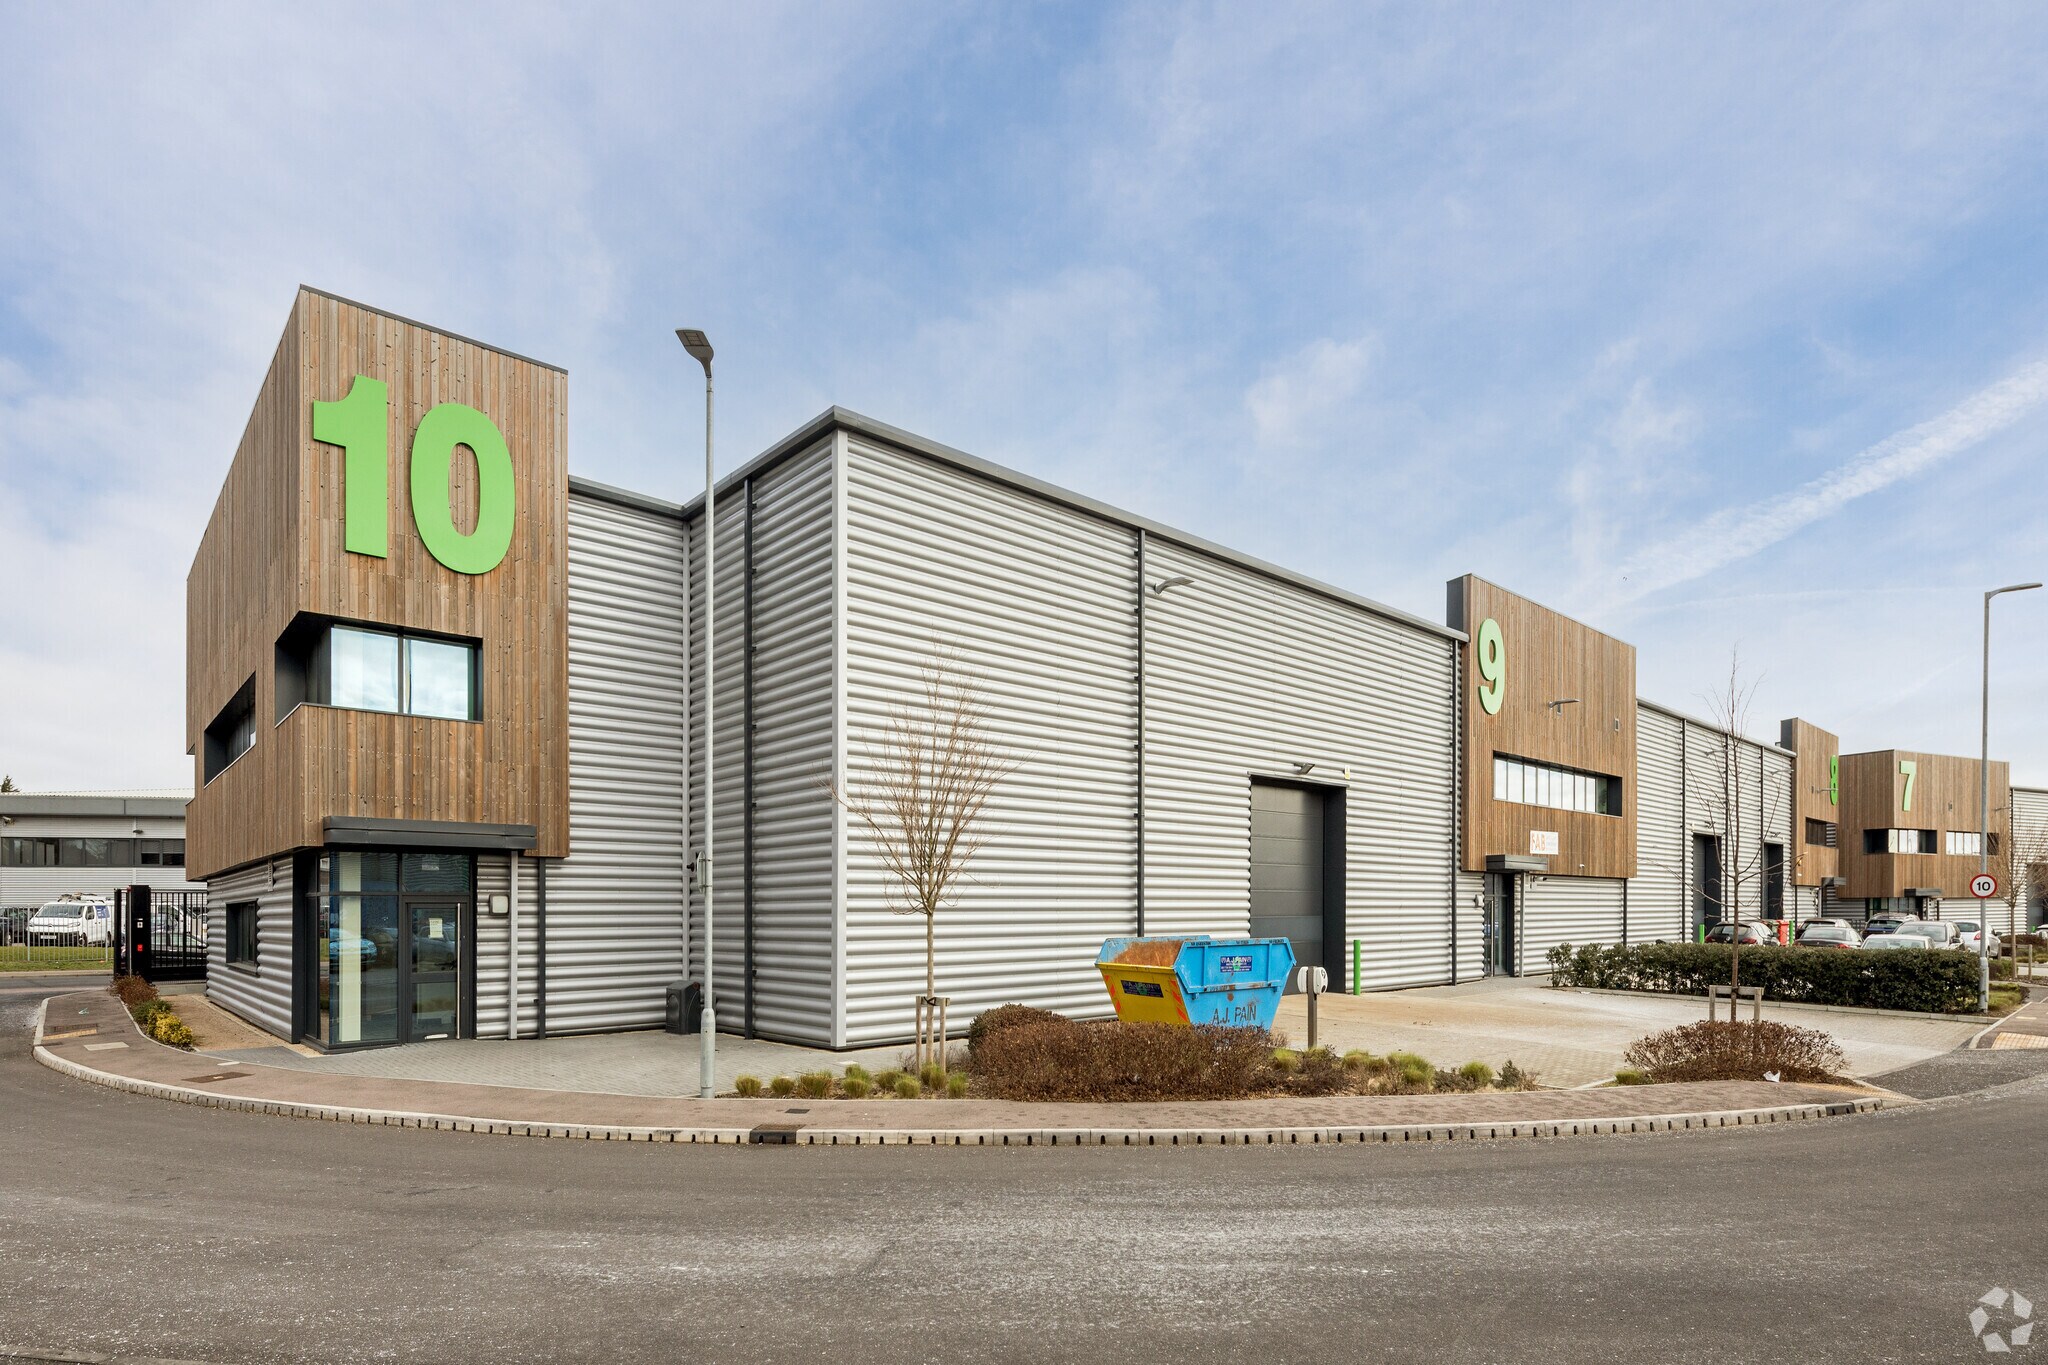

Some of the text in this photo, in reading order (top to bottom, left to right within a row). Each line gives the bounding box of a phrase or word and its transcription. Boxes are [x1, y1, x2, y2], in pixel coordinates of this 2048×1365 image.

[313, 374, 516, 575] 10
[1478, 618, 1506, 715] 9
[1899, 761, 1917, 811] 7
[1531, 832, 1546, 851] FAB
[1976, 881, 1991, 891] 10
[1234, 1004, 1257, 1022] PAIN
